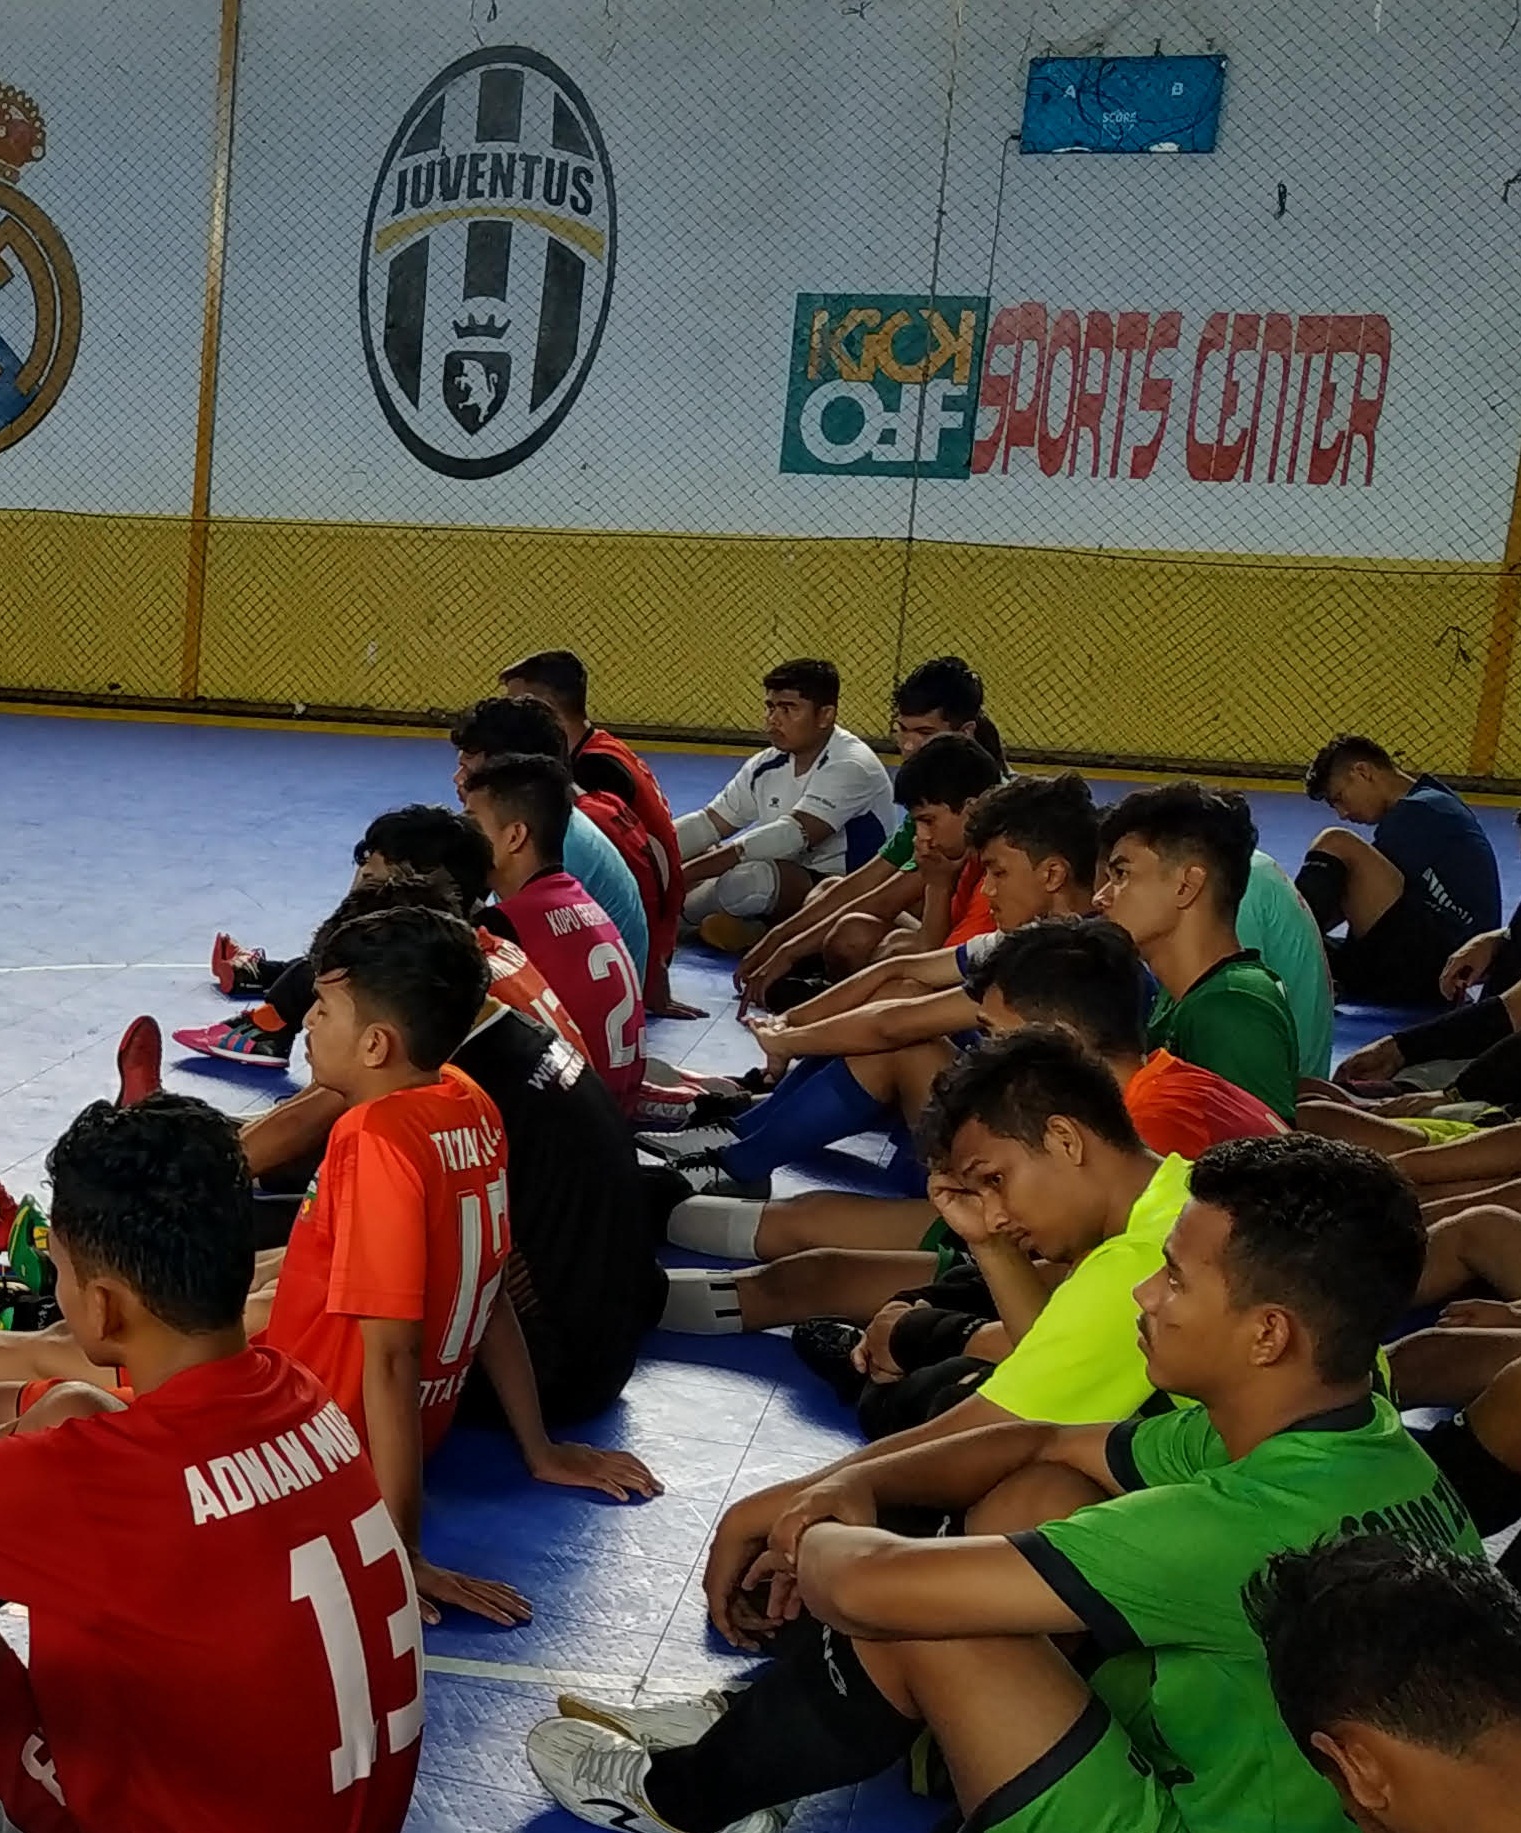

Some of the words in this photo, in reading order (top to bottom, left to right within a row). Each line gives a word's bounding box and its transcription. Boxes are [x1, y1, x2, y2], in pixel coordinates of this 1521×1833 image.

[1064, 85, 1077, 98] A
[1171, 82, 1184, 96] B
[1102, 109, 1138, 124] SCORE
[391, 152, 594, 216] JUVENTUS
[970, 301, 1182, 480] SPORTS
[1185, 312, 1392, 487] CENTER
[184, 1429, 323, 1526] ADNAN
[289, 1498, 426, 1795] 13
